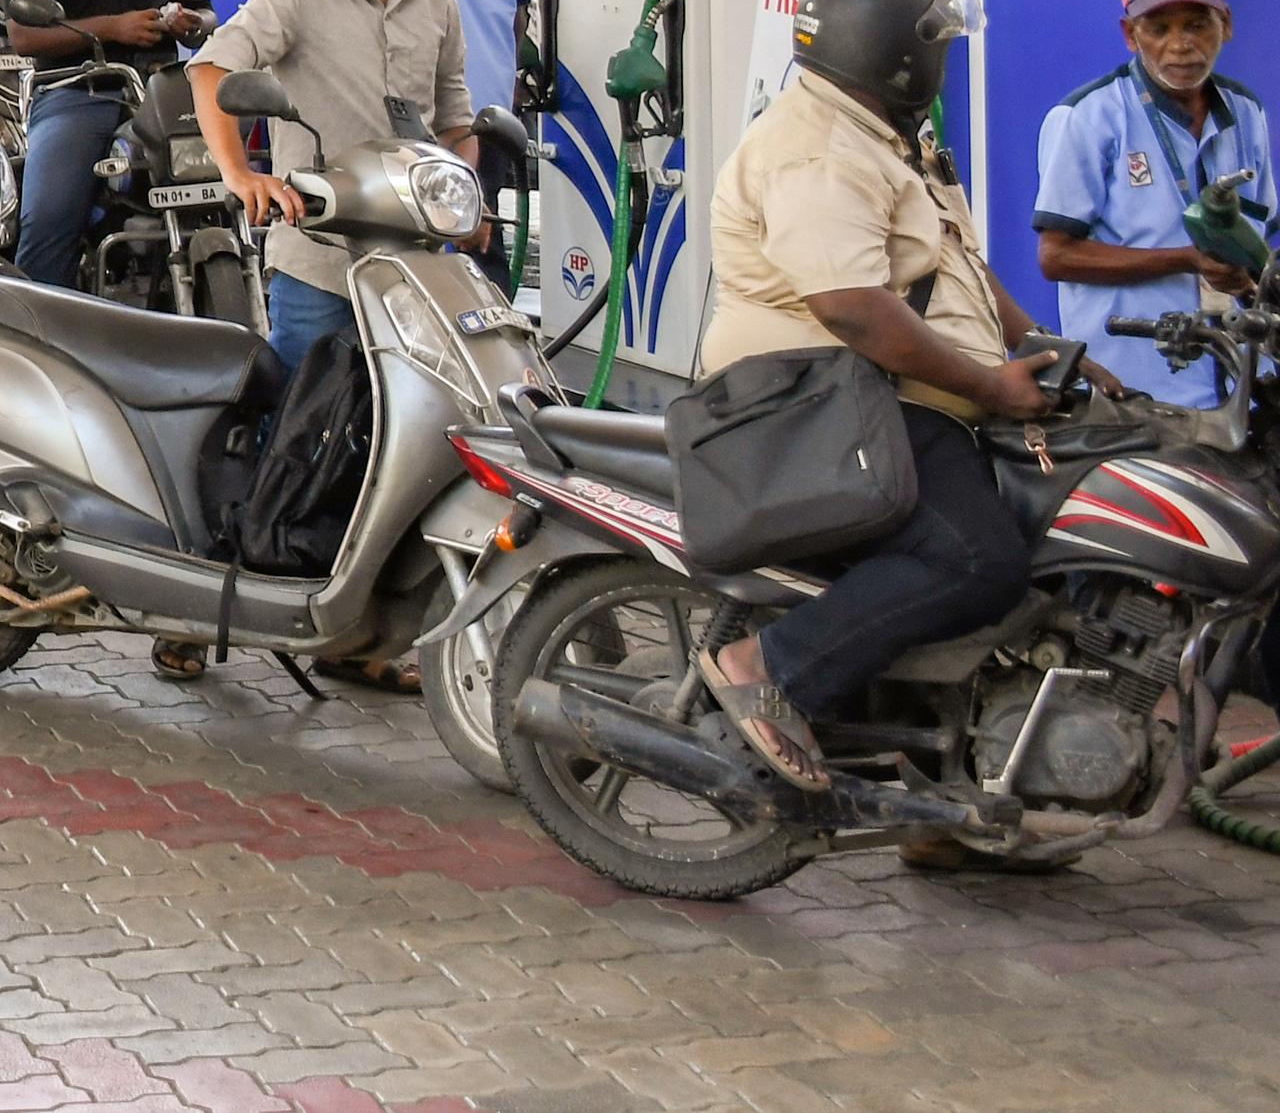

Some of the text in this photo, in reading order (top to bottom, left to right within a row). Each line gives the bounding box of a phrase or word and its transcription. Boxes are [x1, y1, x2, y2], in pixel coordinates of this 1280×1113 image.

[153, 188, 217, 204] TN 01 BA
[569, 253, 589, 272] HP
[480, 309, 501, 324] KA
